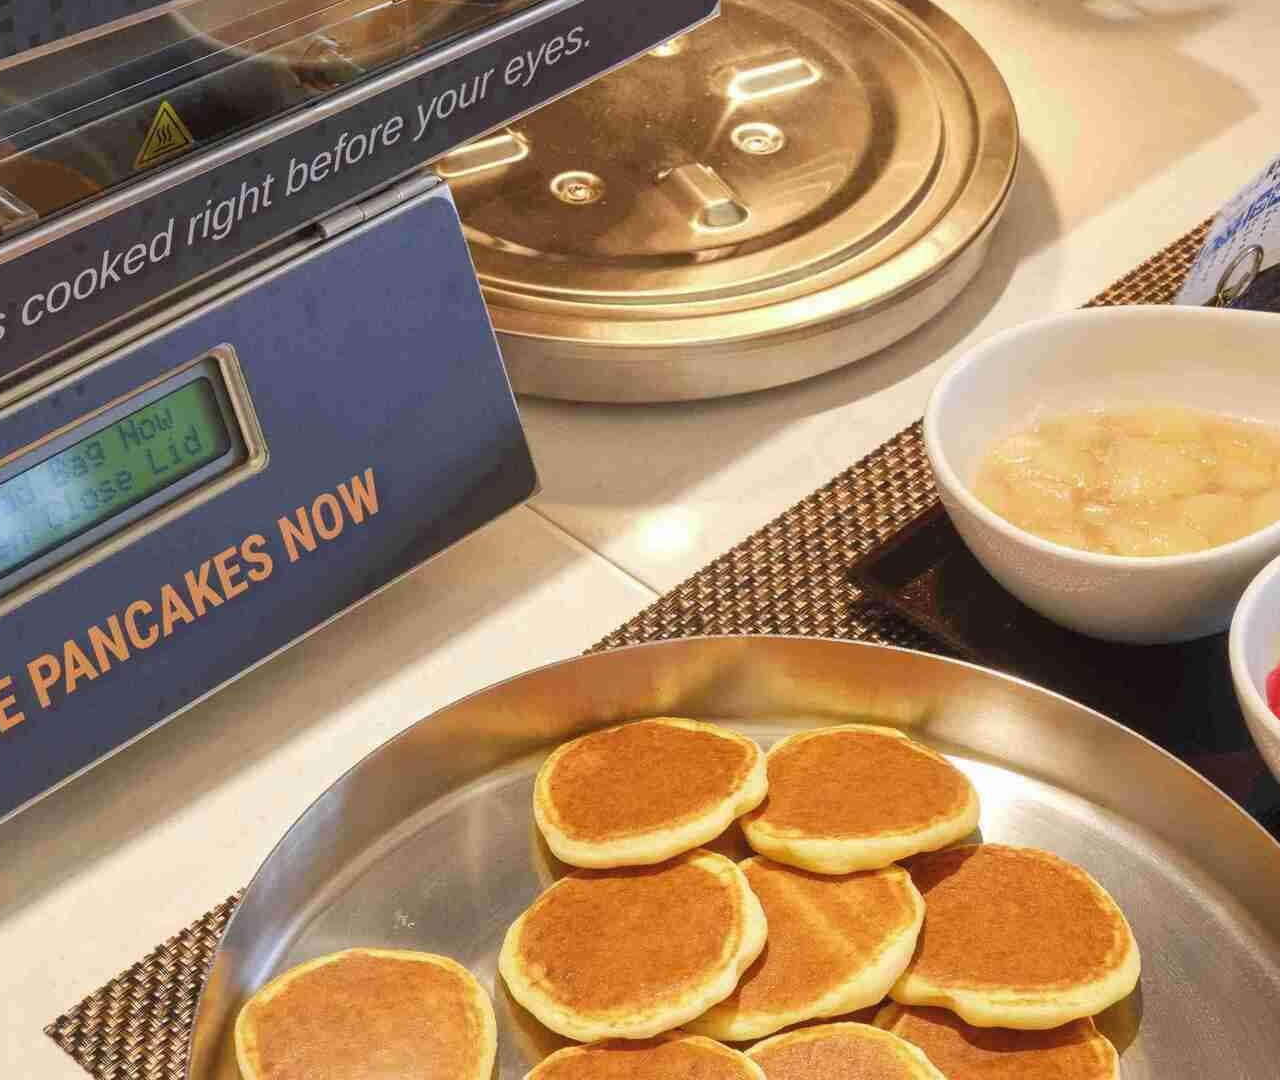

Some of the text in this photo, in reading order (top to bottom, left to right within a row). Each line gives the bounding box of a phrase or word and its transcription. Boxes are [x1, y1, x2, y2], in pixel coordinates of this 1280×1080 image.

[21, 206, 173, 327] cooked
[186, 172, 275, 253] right
[285, 108, 401, 198] before
[413, 66, 495, 143] your
[503, 22, 592, 88] eyes.
[116, 407, 175, 452] Now
[145, 423, 203, 476] Lid
[26, 533, 275, 710] PANCAKES
[276, 466, 380, 564] NOW
